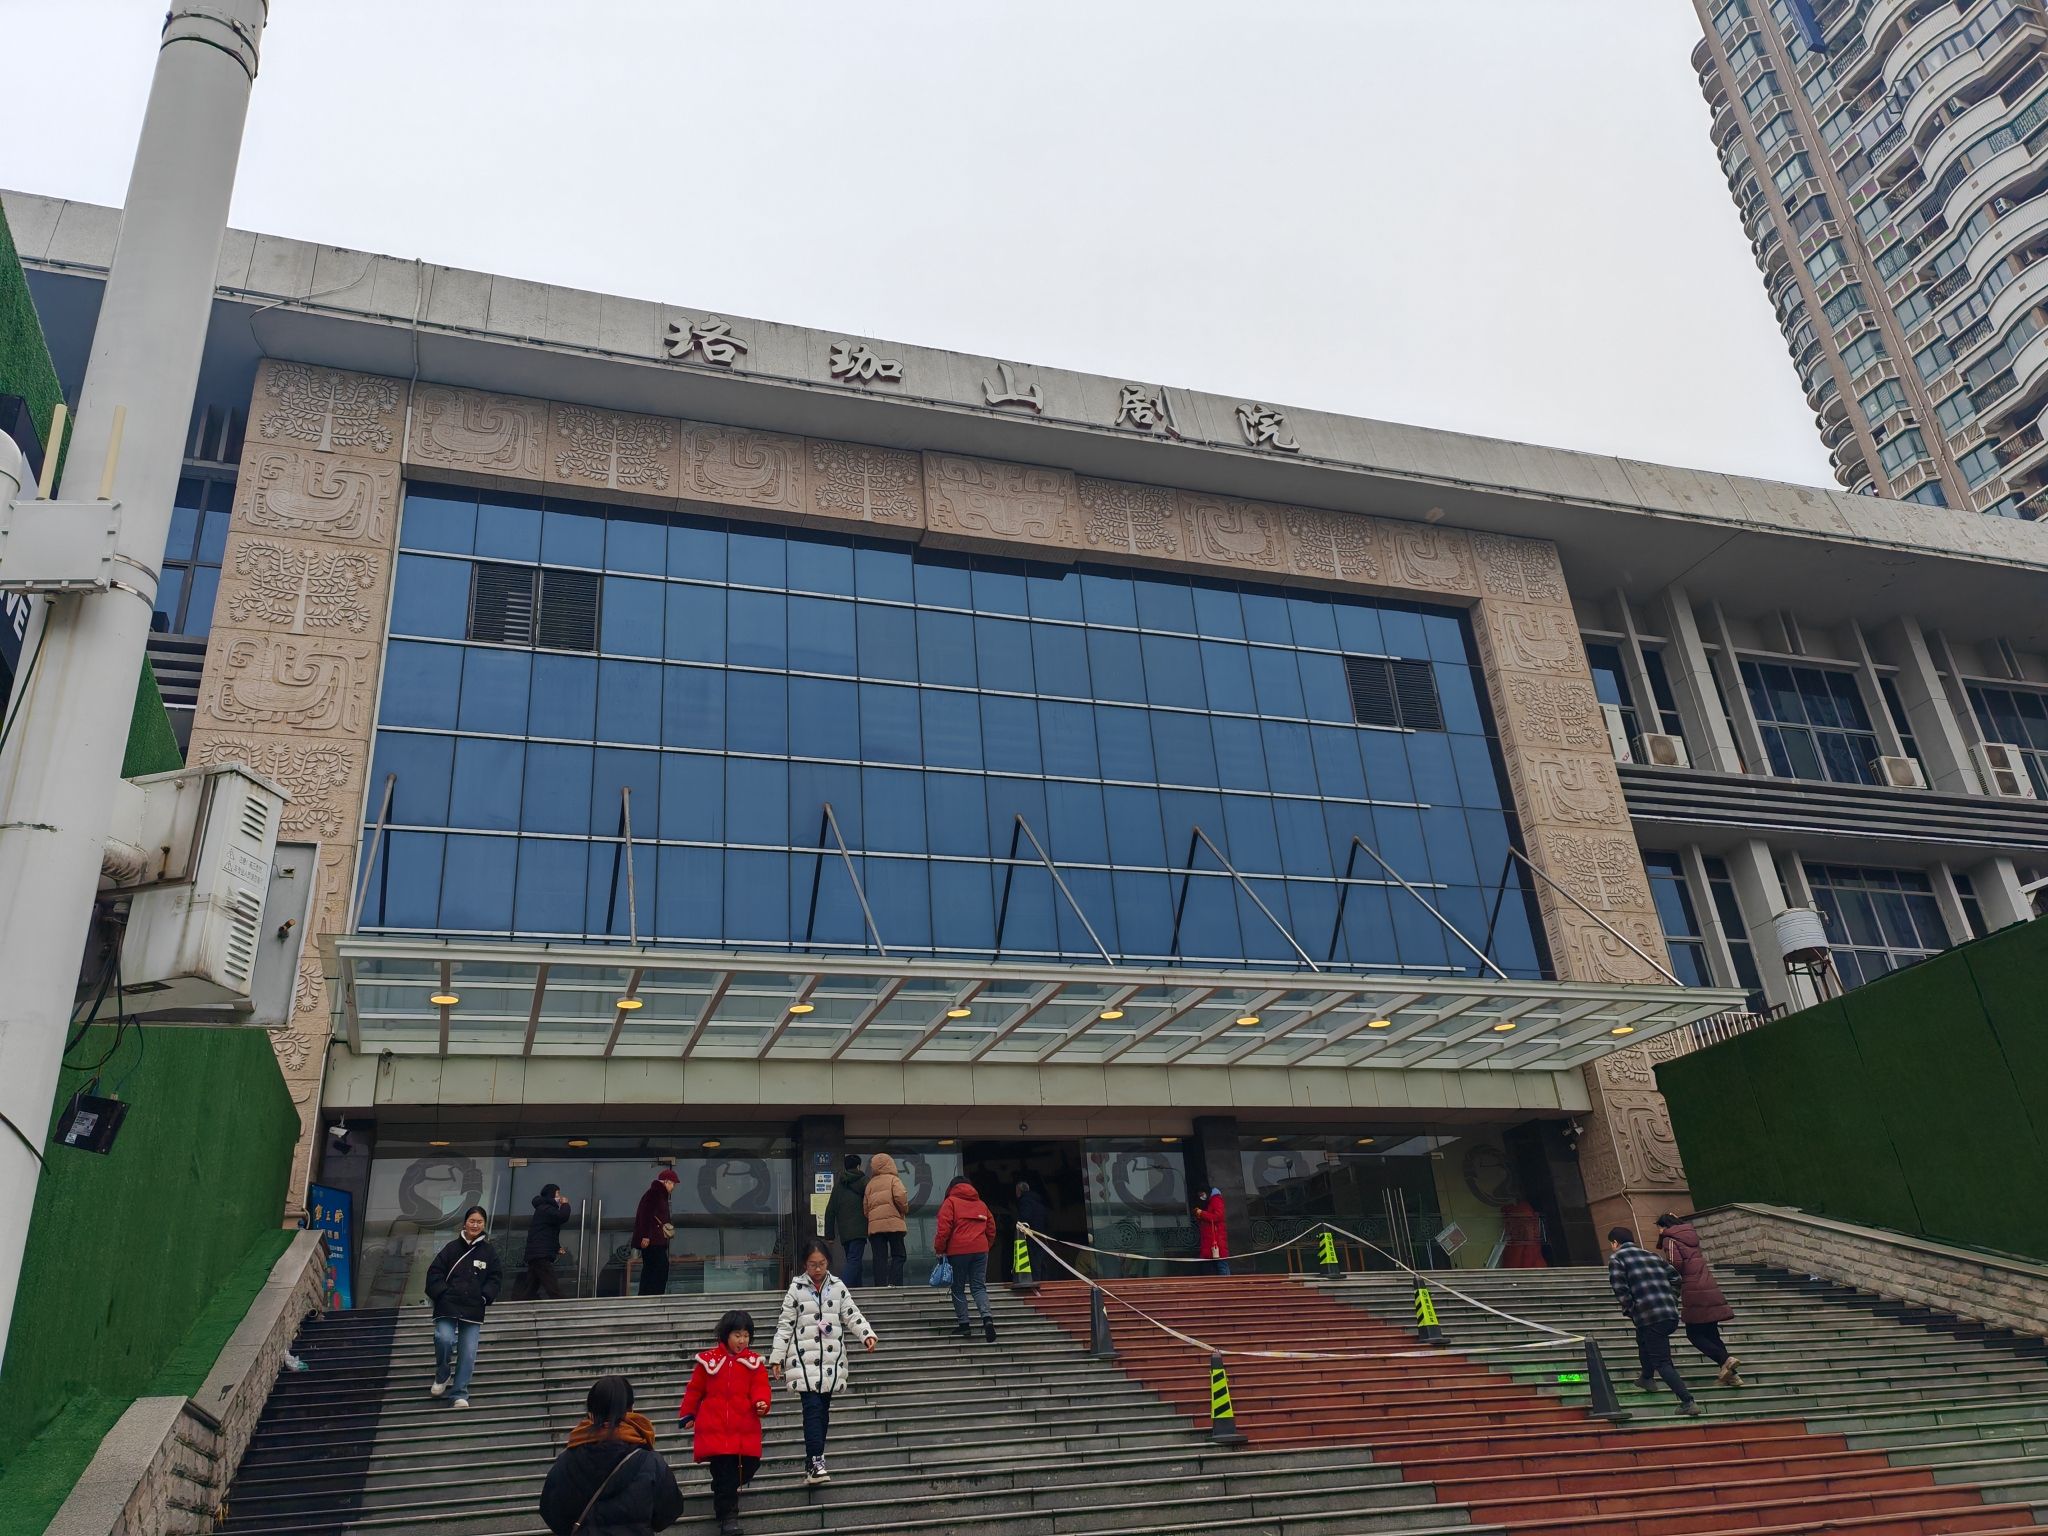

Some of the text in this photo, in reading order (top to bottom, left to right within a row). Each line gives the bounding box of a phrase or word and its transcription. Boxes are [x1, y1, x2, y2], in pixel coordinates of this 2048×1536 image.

[664, 313, 1300, 452] 珞珈山剧院
